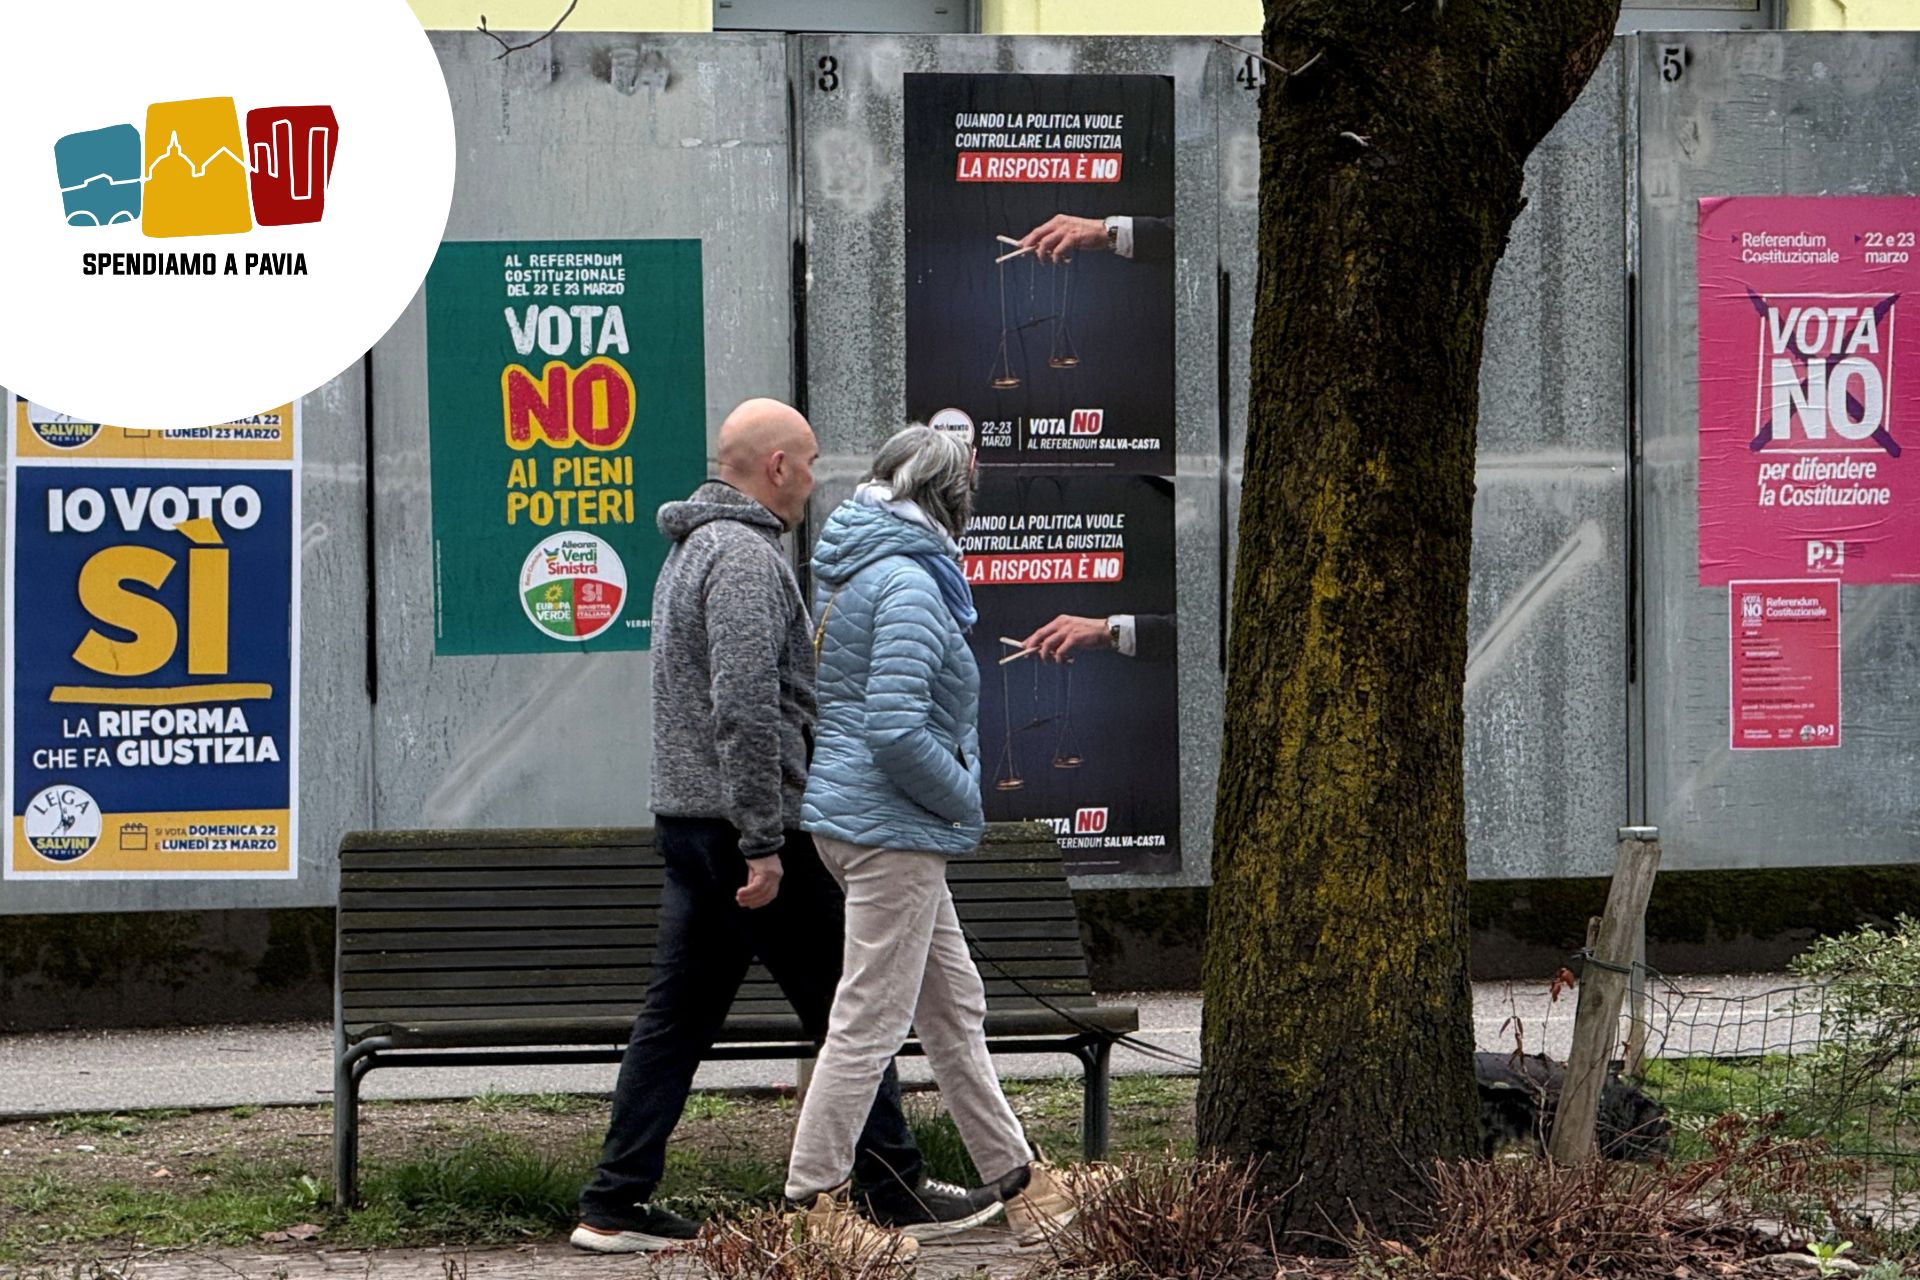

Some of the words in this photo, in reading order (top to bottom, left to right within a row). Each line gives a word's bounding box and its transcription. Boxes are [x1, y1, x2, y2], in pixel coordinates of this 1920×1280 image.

[1237, 55, 1258, 90] 4
[1663, 48, 1682, 82] 5
[818, 55, 839, 92] 3
[955, 113, 1005, 129] QUANDO
[1007, 114, 1023, 128] LA
[1026, 113, 1081, 128] POLITICA
[1084, 114, 1124, 128] VUOLE
[955, 134, 1042, 149] CONTROLLARE
[1045, 134, 1061, 148] LA
[1064, 134, 1122, 149] GIUSTIZIA
[959, 158, 983, 178] LA
[987, 158, 1070, 179] RISPOSTA
[1076, 153, 1087, 177] È
[1091, 159, 1118, 179] NO
[1742, 231, 1826, 247] Referendum
[1865, 233, 1883, 247] 22
[1886, 236, 1893, 247] e
[1897, 232, 1915, 247] 23
[505, 254, 522, 267] AL
[1742, 248, 1839, 264] Costituzionale
[1865, 252, 1908, 263] marzo
[507, 284, 530, 296] DEL
[533, 284, 548, 296] 22
[552, 284, 560, 295] E
[564, 283, 579, 295] 23
[583, 283, 625, 295] MARZO
[504, 304, 629, 356] VOTA
[1768, 307, 1879, 354] VOTA
[501, 357, 636, 450] NO
[1771, 357, 1884, 440] NO
[264, 415, 279, 424] 22
[981, 421, 1012, 434] 22-23
[1029, 418, 1066, 435] VOTA
[1073, 411, 1101, 433] NO
[40, 424, 93, 435] SALVINI
[215, 428, 230, 438] 23
[234, 428, 280, 439] MARZO
[981, 435, 1012, 447] MARZO
[1027, 438, 1038, 449] AL
[1040, 438, 1097, 449] REFERENDUM
[1098, 437, 1161, 450] SALVA-CASTA
[507, 458, 537, 488] AI
[553, 456, 633, 487] PIENI
[1758, 462, 1787, 486] per
[1792, 457, 1877, 480] difendere
[1758, 484, 1775, 506] la
[1779, 482, 1890, 506] Costituzione
[49, 488, 106, 532] IO
[110, 485, 262, 531] VOTO
[507, 489, 634, 526] POTERI
[966, 514, 1007, 530] UANDO
[1009, 515, 1025, 530] LA
[1028, 514, 1082, 529] POLITICA
[1085, 514, 1126, 528] VUOLE
[958, 535, 1045, 551] CONTROLLARE
[1047, 535, 1063, 549] LA
[1066, 534, 1124, 548] GIUSTIZIA
[562, 549, 597, 562] Verdi
[548, 561, 598, 575] Sinistra
[963, 559, 985, 581] LA
[990, 559, 1072, 580] RISPOSTA
[1078, 552, 1089, 578] È
[1093, 557, 1120, 578] NO
[72, 517, 229, 676] SÌ
[582, 583, 603, 602] SI
[1743, 603, 1762, 617] NO
[1766, 597, 1819, 607] Referendum
[537, 611, 571, 620] VERDE
[1766, 607, 1826, 617] Costituzionale
[625, 620, 651, 628] VERDI
[63, 718, 92, 738] LA
[99, 707, 249, 737] RIFORMA
[33, 748, 77, 769] CHE
[84, 748, 111, 768] FA
[116, 736, 280, 766] GIUSTIZIA
[33, 790, 90, 815] LEGA
[1034, 818, 1070, 835] TA
[1077, 809, 1106, 832] NO
[165, 828, 187, 836] VOTA
[189, 825, 257, 835] DOMENICA
[261, 825, 276, 835] 22
[36, 838, 90, 849] SALVINI
[162, 837, 209, 850] LUNEDÌ
[212, 840, 227, 850] 23
[230, 840, 277, 850] MARZO
[1057, 837, 1102, 848] FERENDUM
[1104, 835, 1165, 848] SALVA-CASTA
